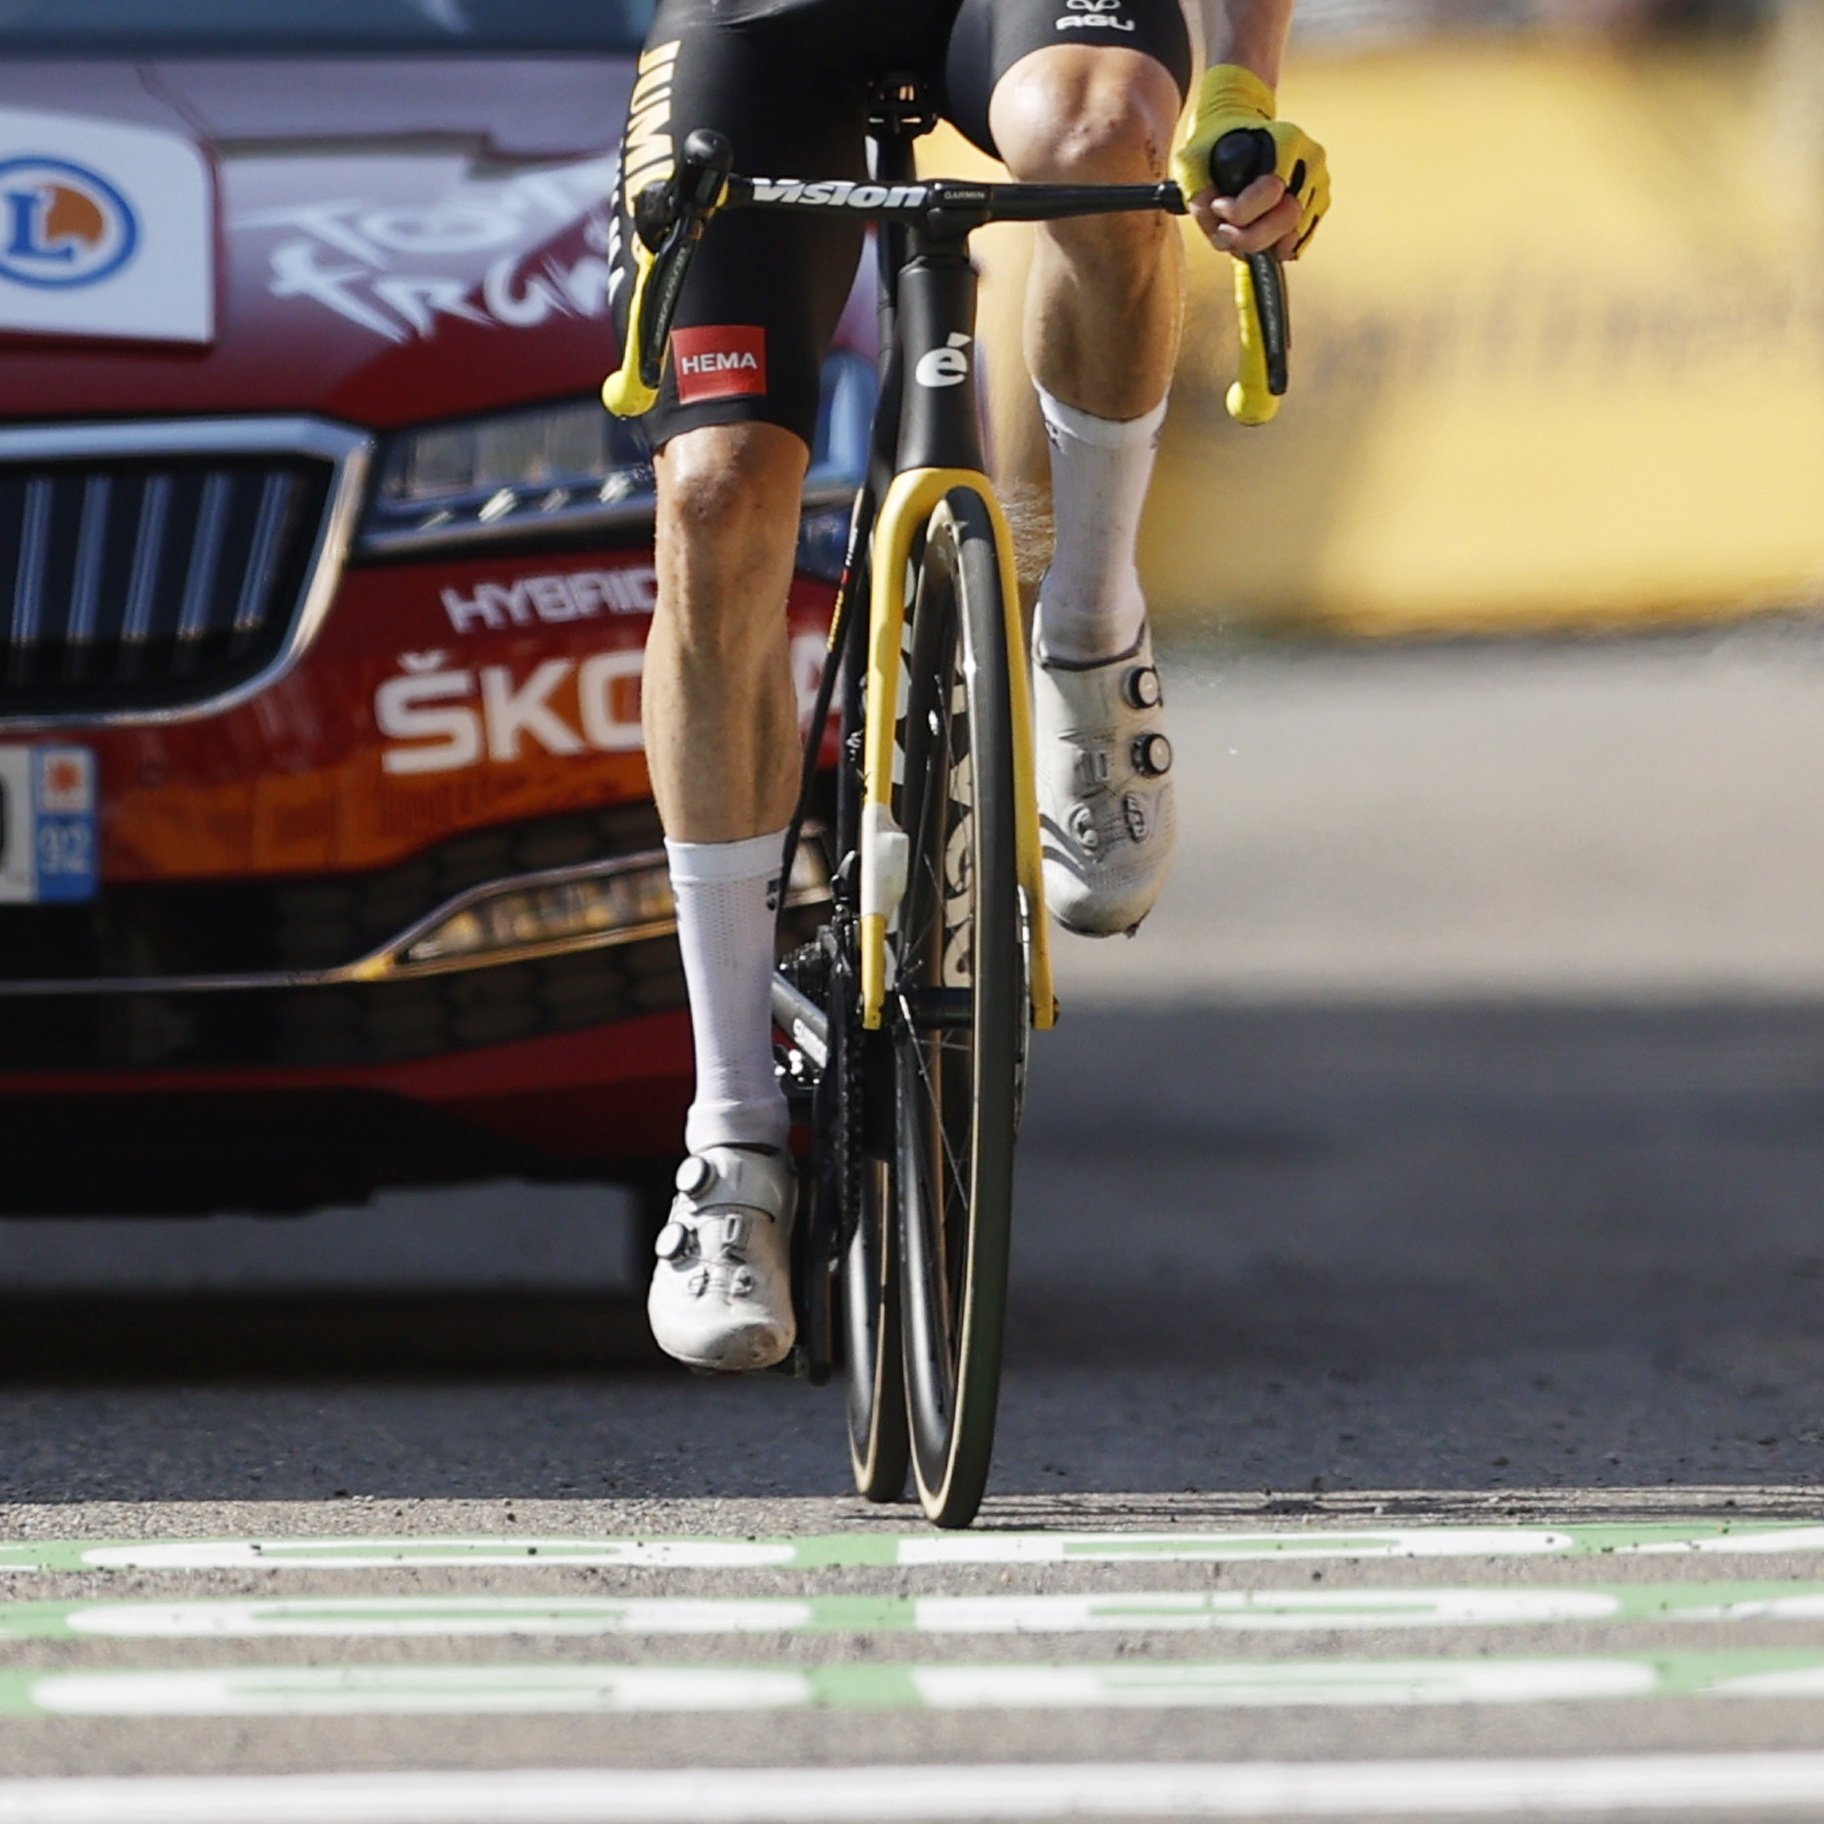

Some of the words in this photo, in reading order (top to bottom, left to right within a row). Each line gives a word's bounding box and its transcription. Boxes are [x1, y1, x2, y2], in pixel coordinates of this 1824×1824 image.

[1055, 13, 1135, 31] AGU
[944, 190, 986, 200] GARMIN
[681, 352, 758, 376] HEMA
